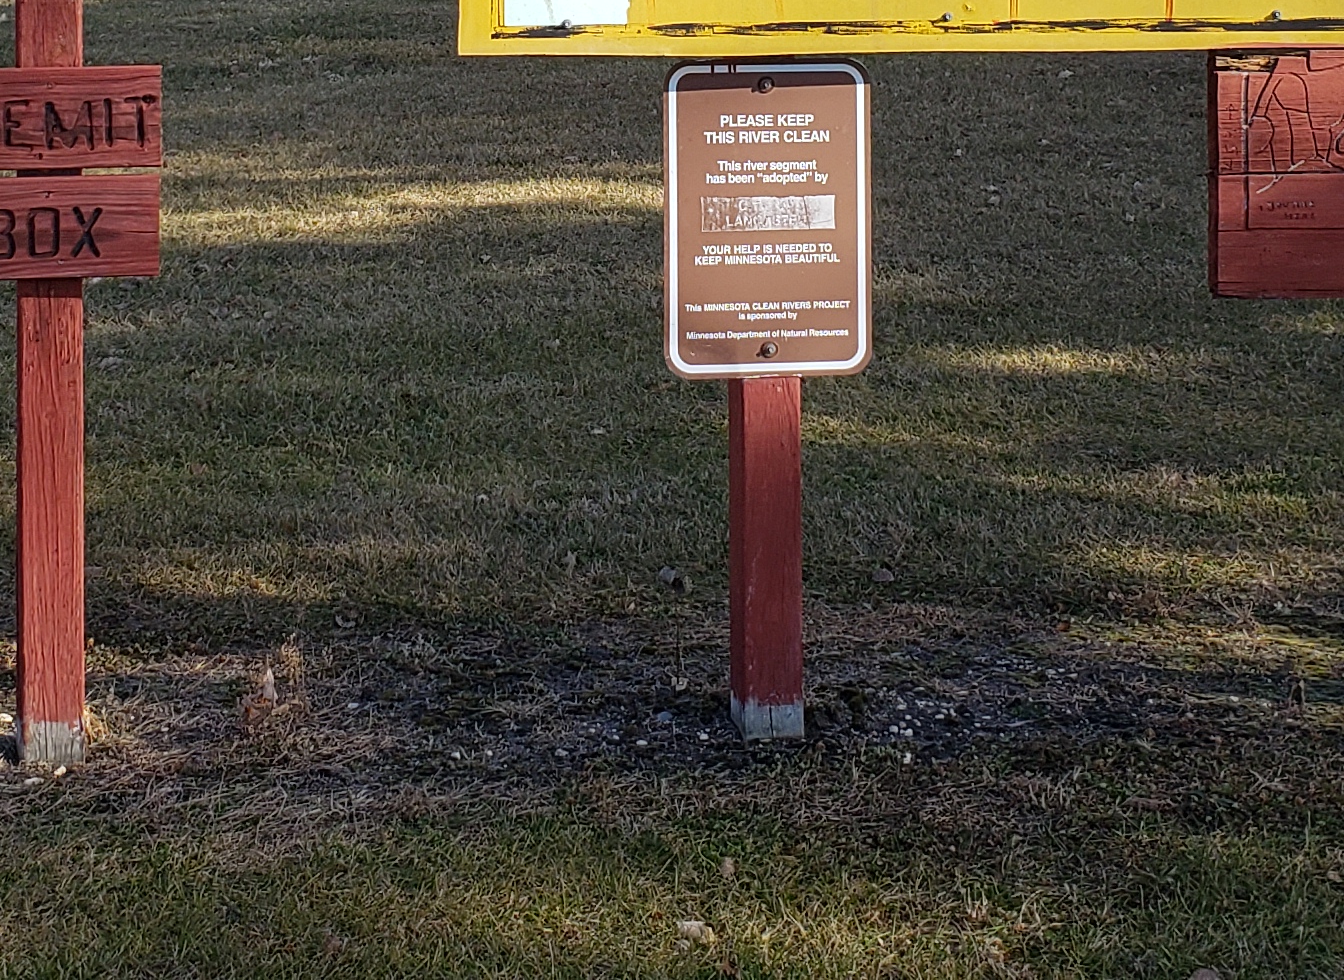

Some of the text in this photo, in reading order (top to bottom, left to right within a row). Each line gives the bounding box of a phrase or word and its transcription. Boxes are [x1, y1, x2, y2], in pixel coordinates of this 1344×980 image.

[720, 114, 814, 127] PLEASE KEEP
[704, 130, 830, 144] THIS RIVER CLEAN
[717, 159, 817, 172] This river segment
[706, 173, 726, 184] has
[727, 173, 755, 183] been
[814, 171, 829, 184] by
[703, 243, 833, 255] YOUR HELP IS NEEDED TO
[694, 254, 841, 266] KEEP MINNESOTA BEAUTIFUL
[684, 300, 851, 312] This MINNESOTA CLEAN RIVERS PROJECT
[738, 311, 798, 321] is sponsored by
[686, 328, 849, 340] Minnesota Department of Natural Resources
